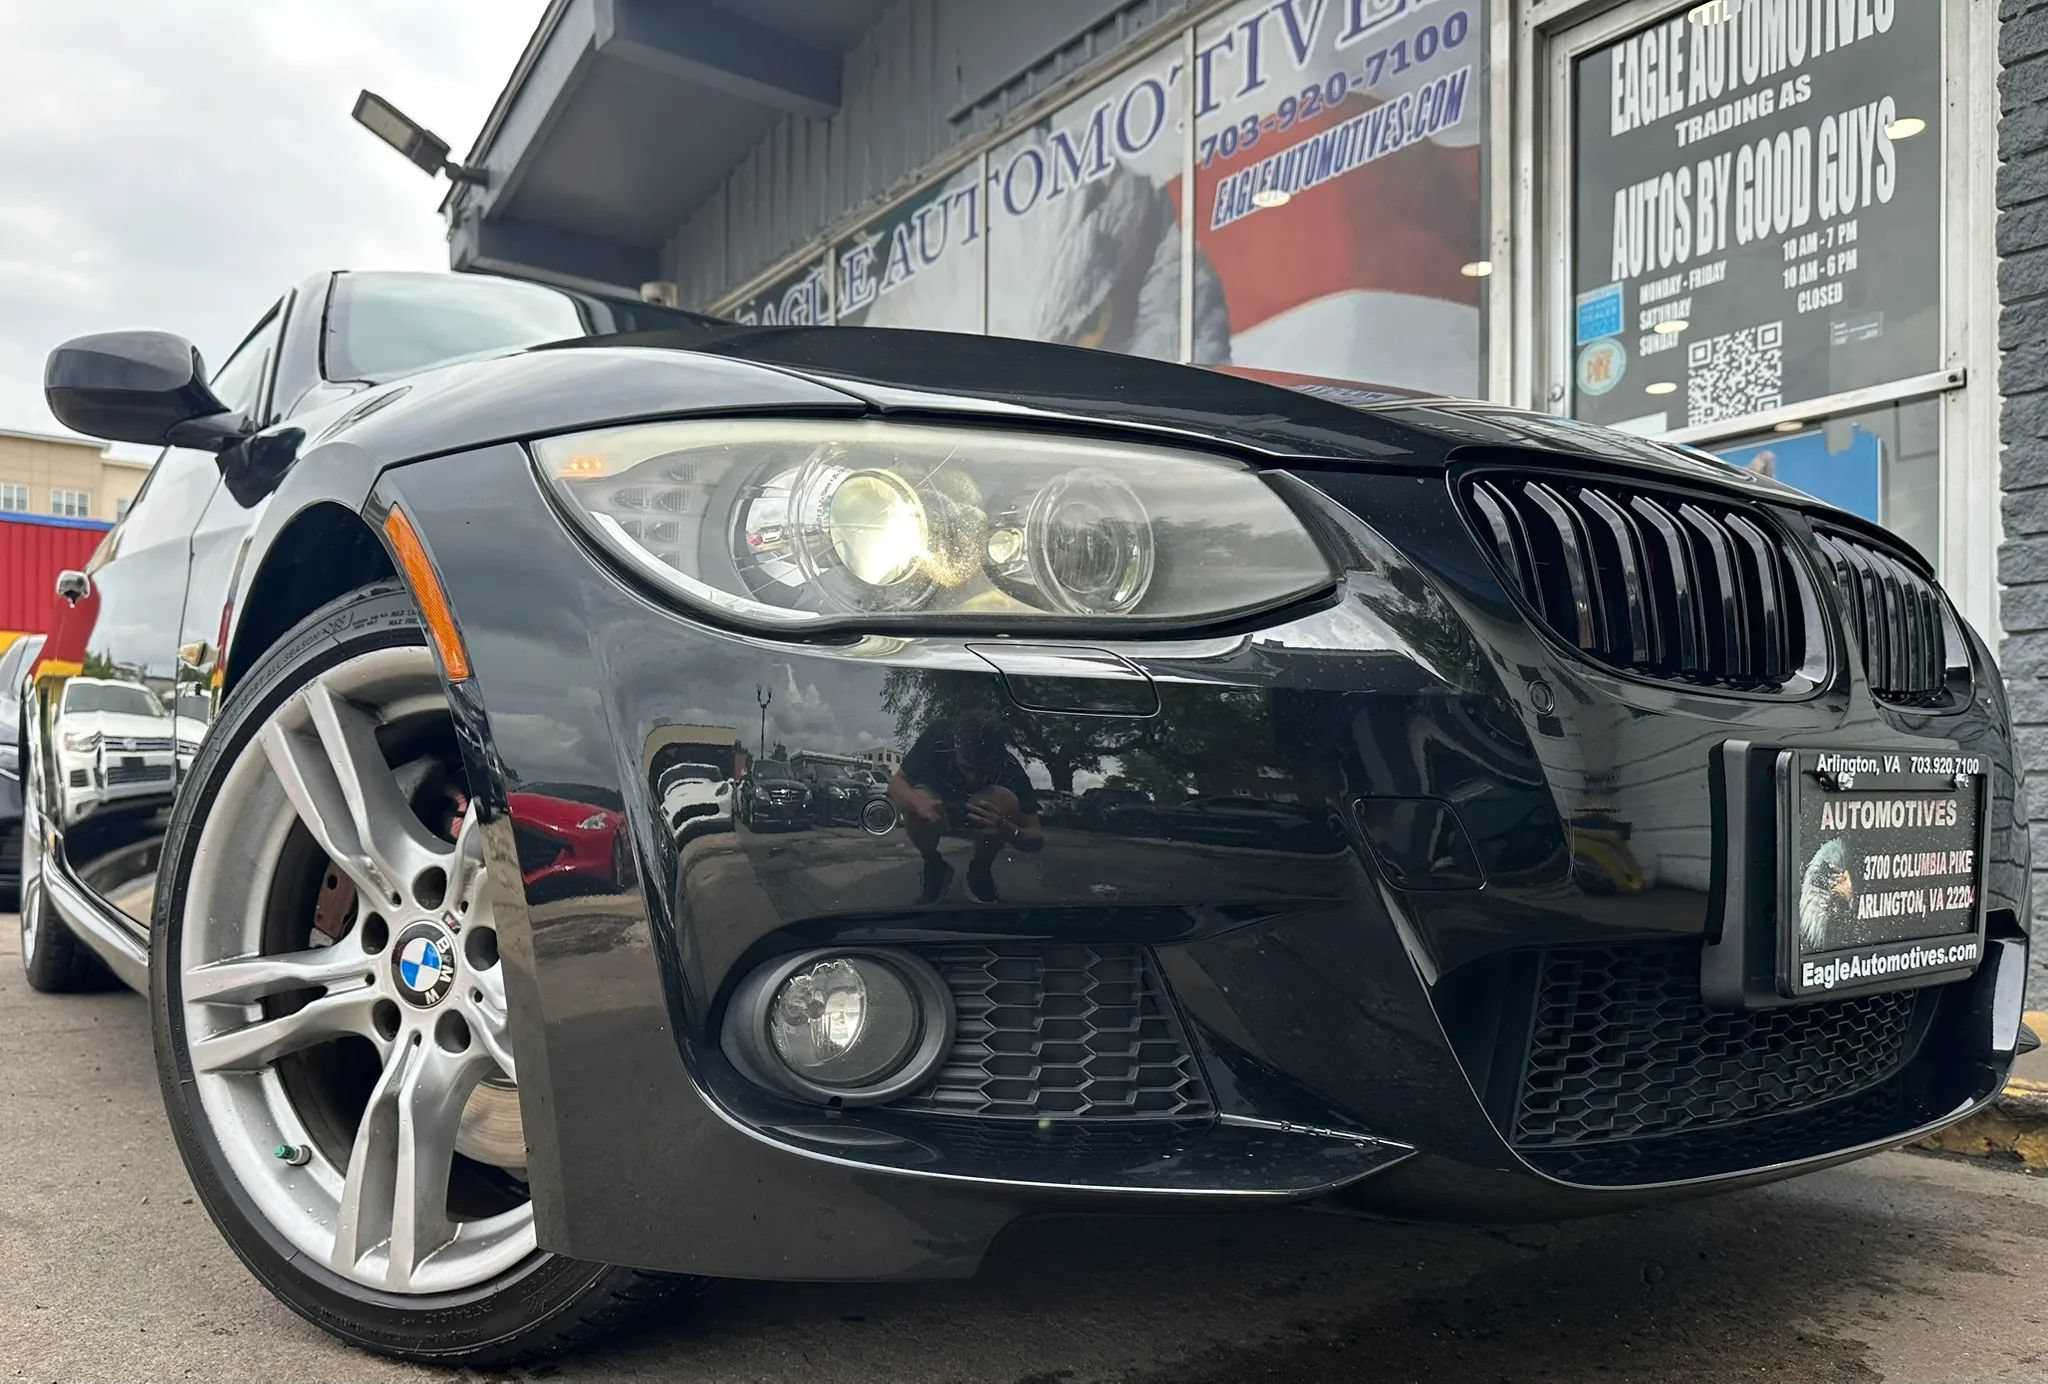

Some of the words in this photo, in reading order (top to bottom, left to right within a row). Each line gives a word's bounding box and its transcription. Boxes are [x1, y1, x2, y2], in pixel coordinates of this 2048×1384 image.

[1201, 11, 1468, 166] 703-920-7100
[1611, 18, 1684, 137] EAGLE
[1675, 88, 1775, 148] TRADING
[1778, 74, 1812, 111] AS
[1211, 67, 1471, 230] EAGLEAUTOMOTIVES.COM
[1612, 166, 1691, 281] AUTOS
[1697, 151, 1732, 256] BY
[1735, 126, 1811, 246] GOOD
[1818, 96, 1896, 221] GUYS
[1782, 238, 1797, 261] 10
[1798, 231, 1818, 257] AM
[1826, 226, 1835, 249] 7
[1837, 219, 1858, 245] PM
[1640, 272, 1683, 306] MONDAY
[1689, 259, 1727, 291] FRIDAY
[1782, 266, 1797, 289] 10
[1798, 259, 1818, 285] AM
[1826, 254, 1836, 277] 6
[1837, 247, 1858, 274] PM
[1640, 296, 1692, 331] SATURDAY
[1797, 281, 1844, 314] CLOSED
[1640, 331, 1679, 357] SUNDAY
[1816, 753, 1880, 775] Arlington,
[1883, 755, 1901, 773] VA
[1910, 756, 1980, 775] 703.920.7100
[1820, 799, 1958, 831] AUTOMOTIVES
[1863, 855, 1890, 881] 3700
[1892, 851, 1947, 879] COLUMBIA
[1949, 849, 1974, 875] PIKE
[1857, 888, 1927, 919] ARLINGTON,
[1929, 887, 1944, 912] VA
[1945, 884, 1976, 910] 22204
[424, 935, 454, 1005] BMW
[1802, 942, 1978, 989] EagleAutomotives.com
